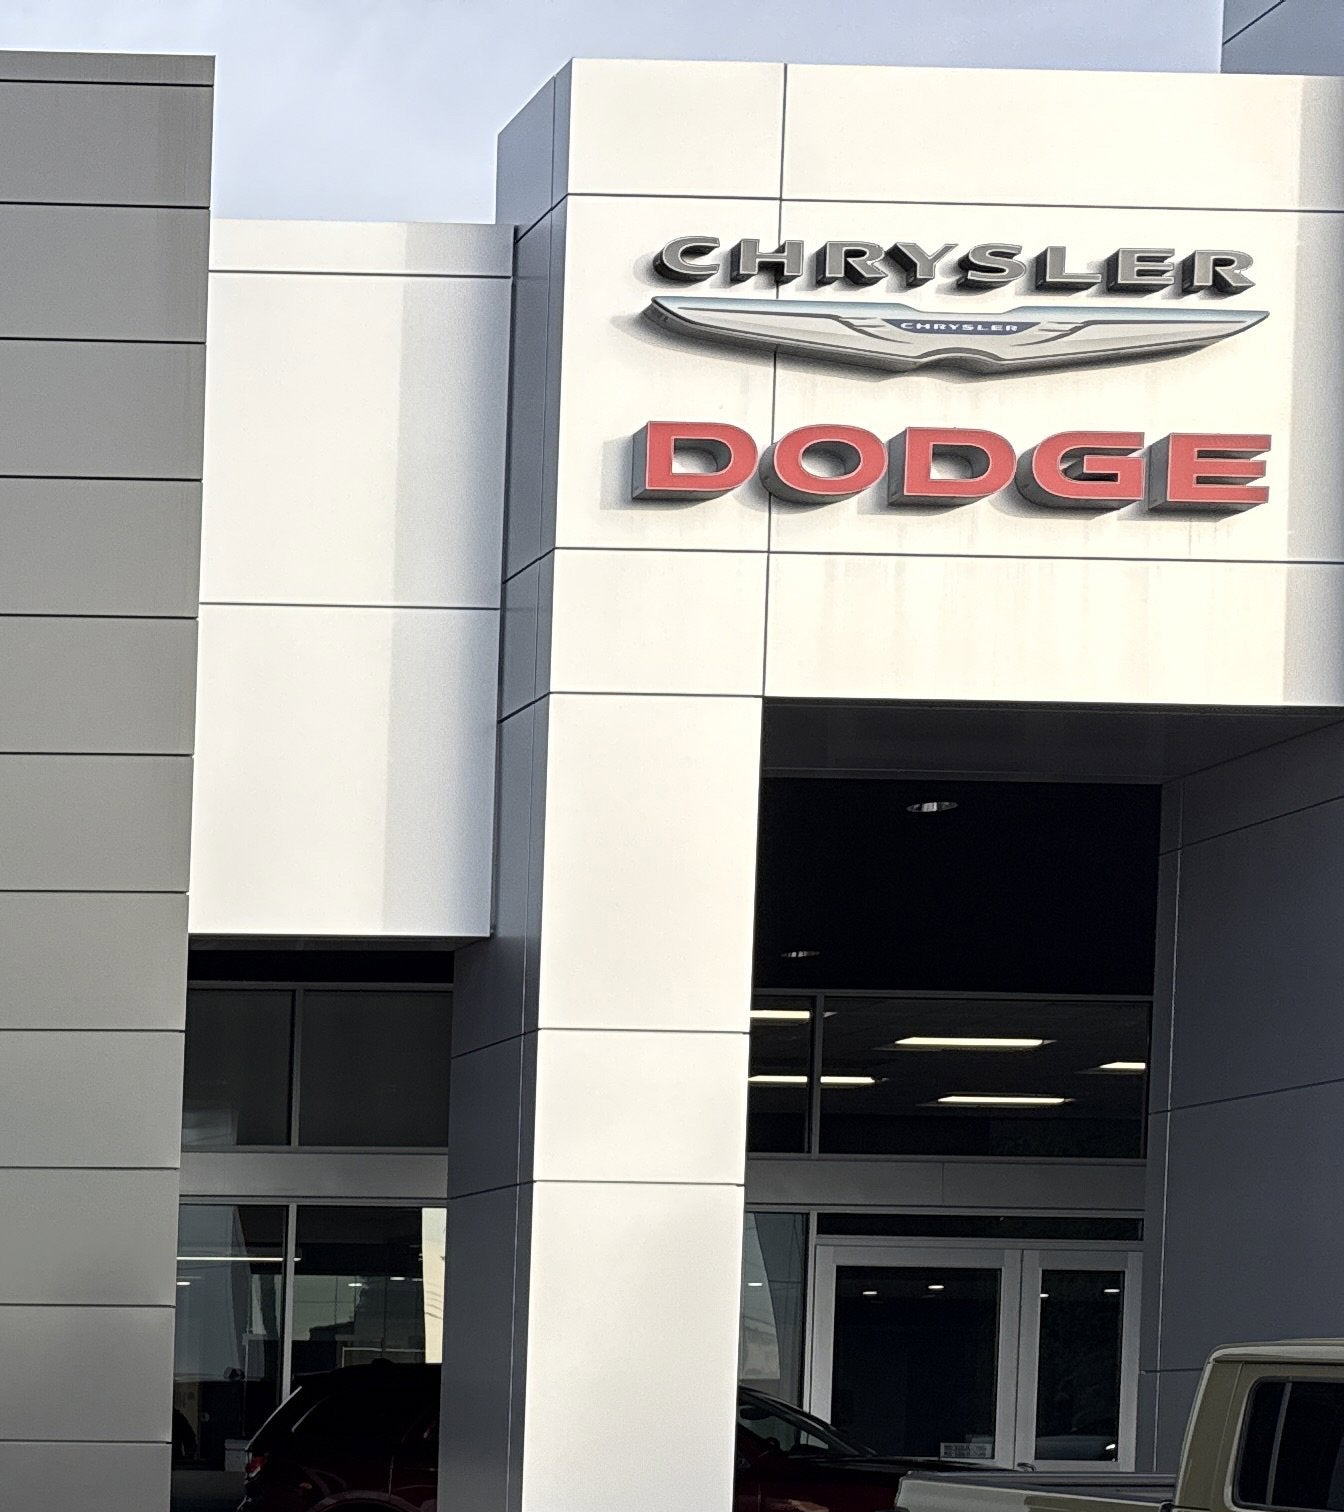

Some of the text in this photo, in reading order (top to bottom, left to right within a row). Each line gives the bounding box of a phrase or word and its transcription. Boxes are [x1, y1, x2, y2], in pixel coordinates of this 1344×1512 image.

[653, 235, 1257, 292] CHRYSLER
[900, 321, 1019, 332] CHRYSLER
[634, 421, 1272, 507] DODGE
